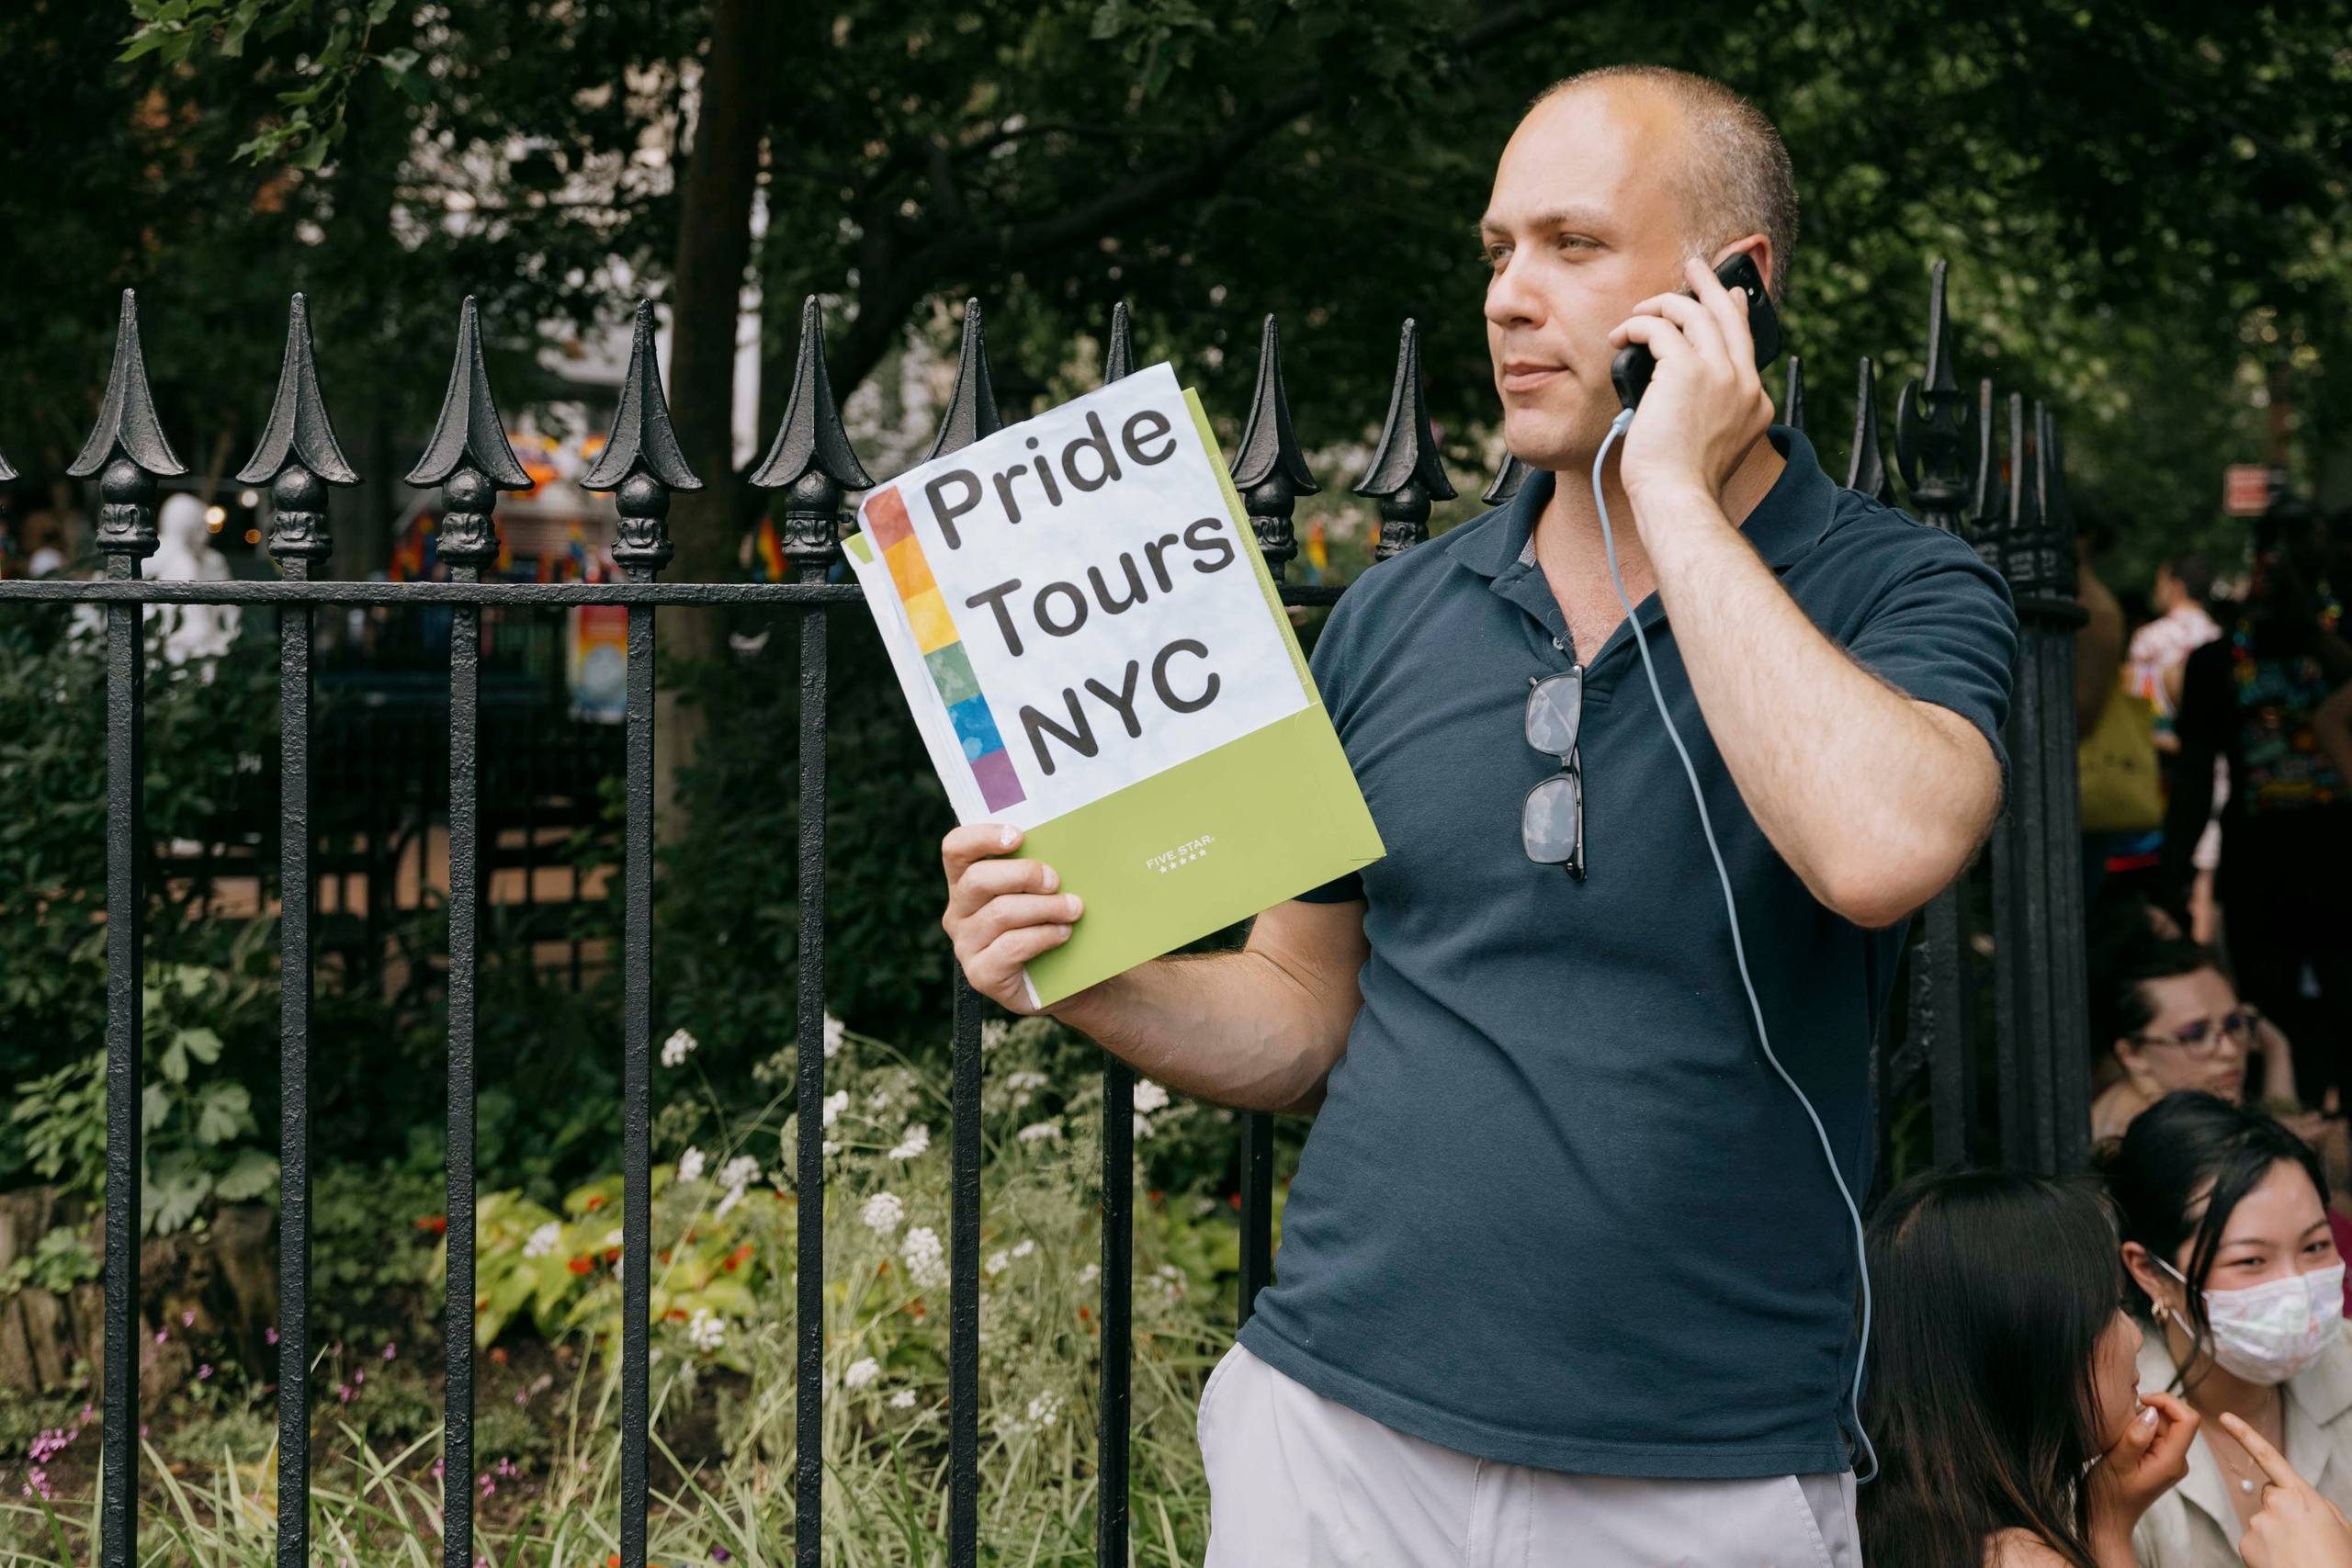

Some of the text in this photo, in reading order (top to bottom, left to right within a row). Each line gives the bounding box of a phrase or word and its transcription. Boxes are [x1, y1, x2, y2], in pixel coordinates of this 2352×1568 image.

[924, 410, 1177, 550] Pride
[966, 517, 1235, 657] Tours
[1019, 638, 1220, 776] NYC
[1146, 850, 1176, 870] FIVE
